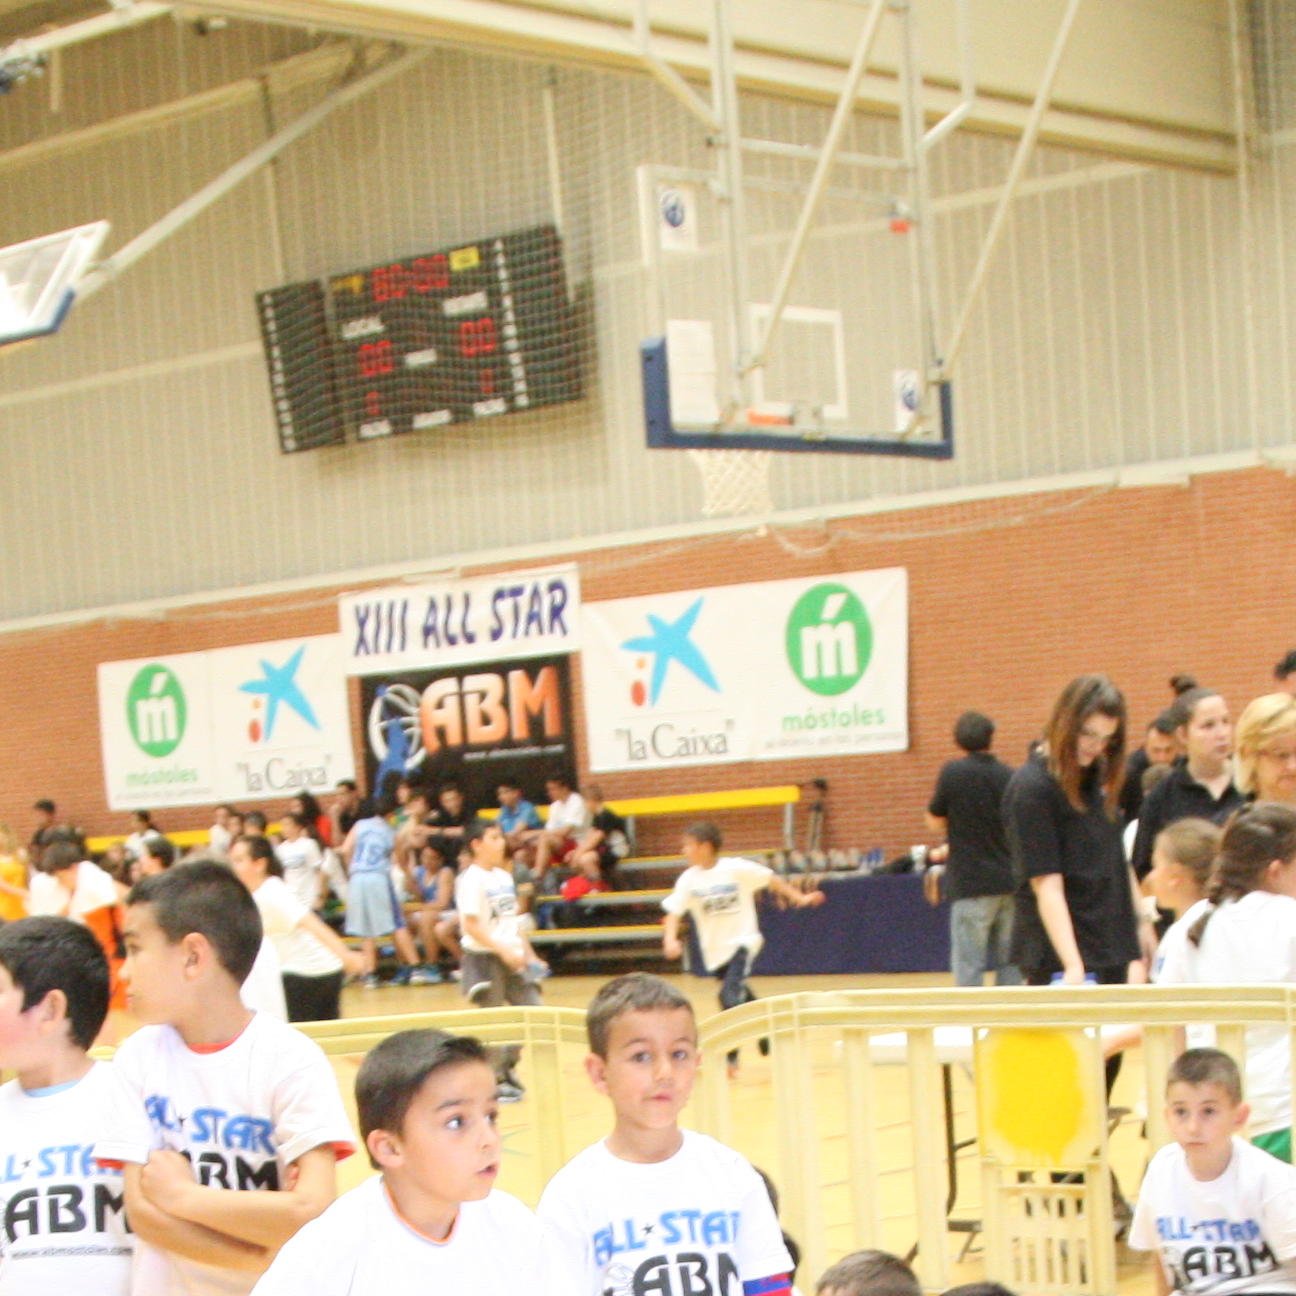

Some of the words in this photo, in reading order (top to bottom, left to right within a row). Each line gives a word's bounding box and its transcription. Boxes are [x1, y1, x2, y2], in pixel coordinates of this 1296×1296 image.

[355, 599, 408, 656] XIII
[422, 594, 476, 649] ALL
[489, 579, 568, 642] STAR
[420, 666, 561, 754] ABM
[781, 702, 885, 731] móstoles
[190, 1106, 277, 1155] STAR
[37, 1143, 124, 1177] STA
[180, 1150, 281, 1192] BM
[5, 1183, 135, 1243] ABM
[592, 1219, 647, 1267] ALL
[1182, 1241, 1280, 1284] ABM
